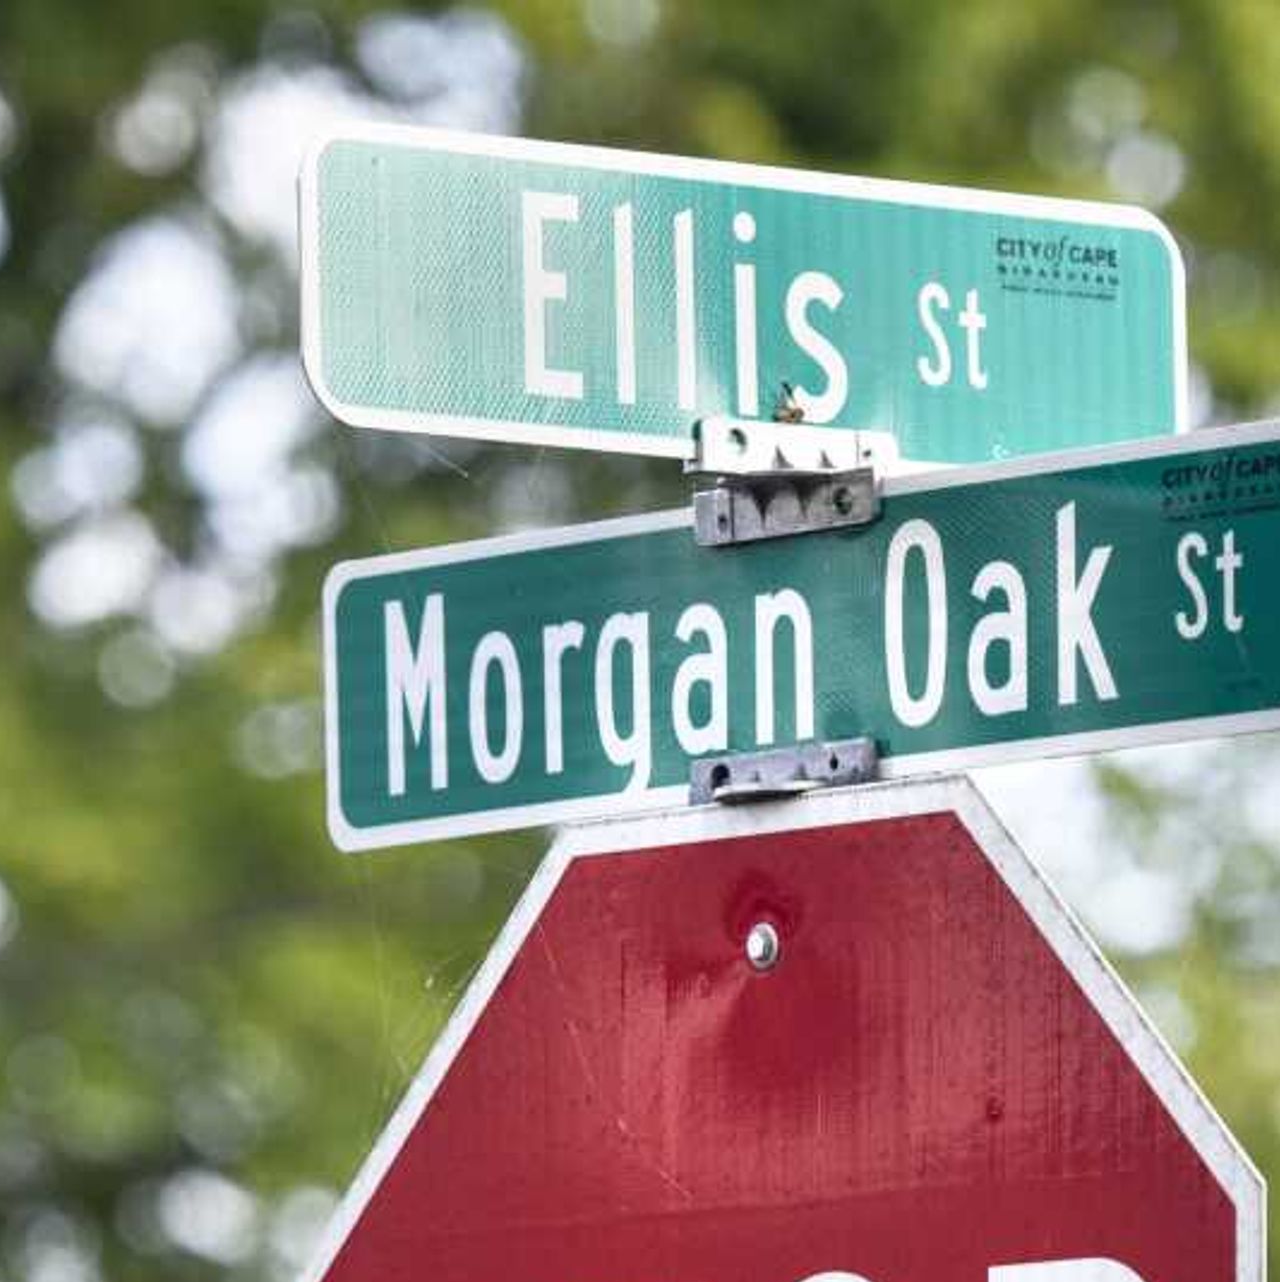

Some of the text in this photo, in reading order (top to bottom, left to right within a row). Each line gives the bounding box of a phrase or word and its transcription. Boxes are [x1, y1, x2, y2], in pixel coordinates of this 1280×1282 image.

[521, 190, 987, 422] Ellis St
[997, 237, 1042, 259] CITY
[1069, 245, 1118, 268] CAPE
[1161, 464, 1208, 489] CITY
[384, 502, 1243, 797] Morgan Oak St
